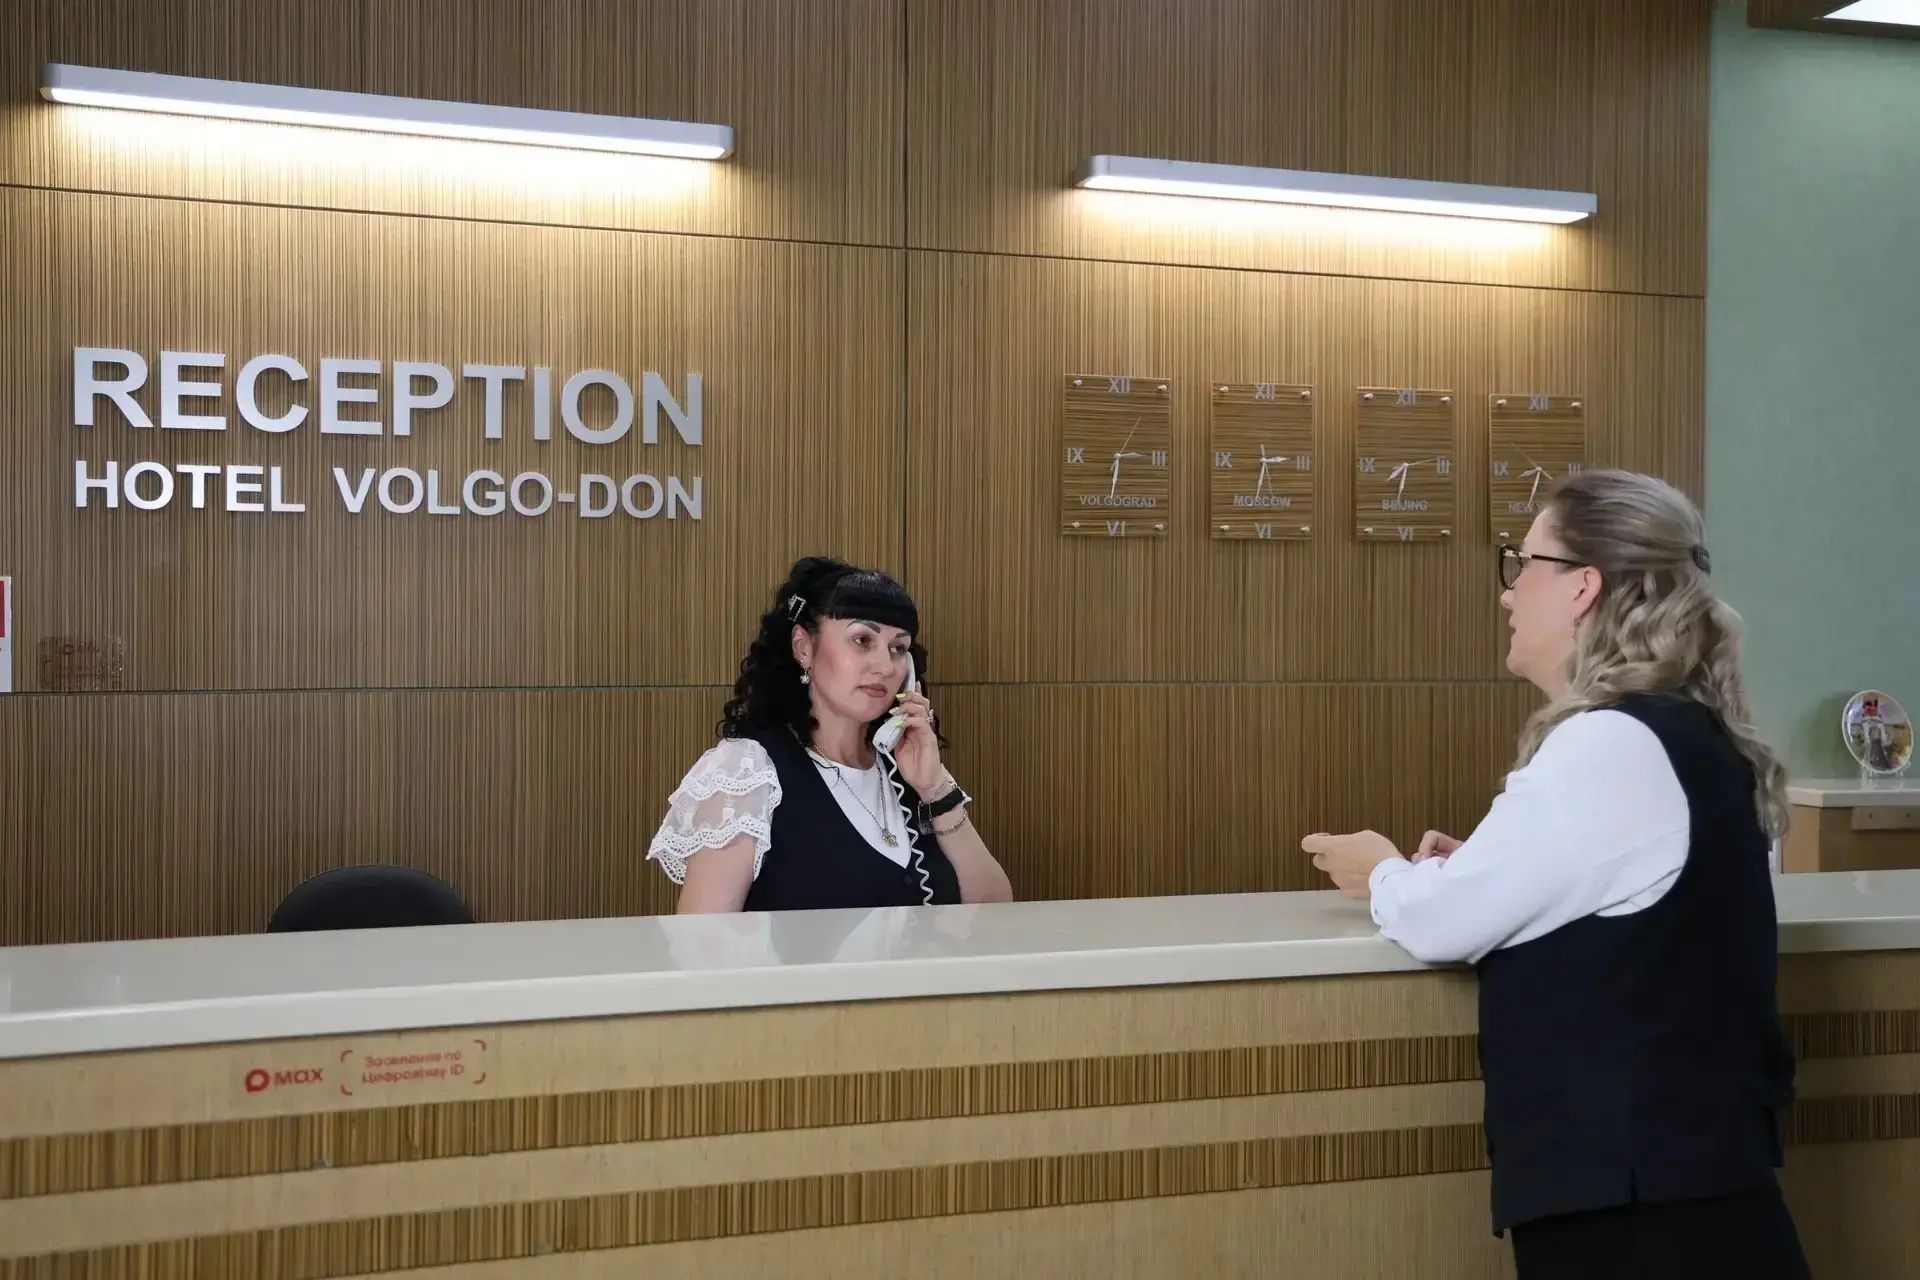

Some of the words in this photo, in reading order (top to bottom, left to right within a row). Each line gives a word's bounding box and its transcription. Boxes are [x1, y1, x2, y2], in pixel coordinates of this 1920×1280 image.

[1108, 377, 1131, 394] XII
[1254, 383, 1276, 400] XII
[74, 346, 703, 446] RECEPTION
[1395, 389, 1416, 405] XII
[1529, 394, 1549, 411] XII
[1066, 447, 1085, 464] IX
[1151, 450, 1167, 467] III
[1215, 451, 1233, 468] IX
[1296, 455, 1311, 470] III
[1359, 457, 1375, 473] IX
[1436, 457, 1450, 473] III
[1494, 461, 1509, 477] IX
[75, 460, 306, 513] HOTEL
[332, 467, 703, 520] VOLGO-DON
[1079, 495, 1157, 509] VOLGOGRAD
[1233, 495, 1292, 508] MOSCOW
[1382, 499, 1429, 511] BEIJING
[1106, 520, 1126, 537] VI
[1254, 522, 1272, 539] VI
[1398, 527, 1414, 541] VI
[450, 1063, 465, 1076] ID
